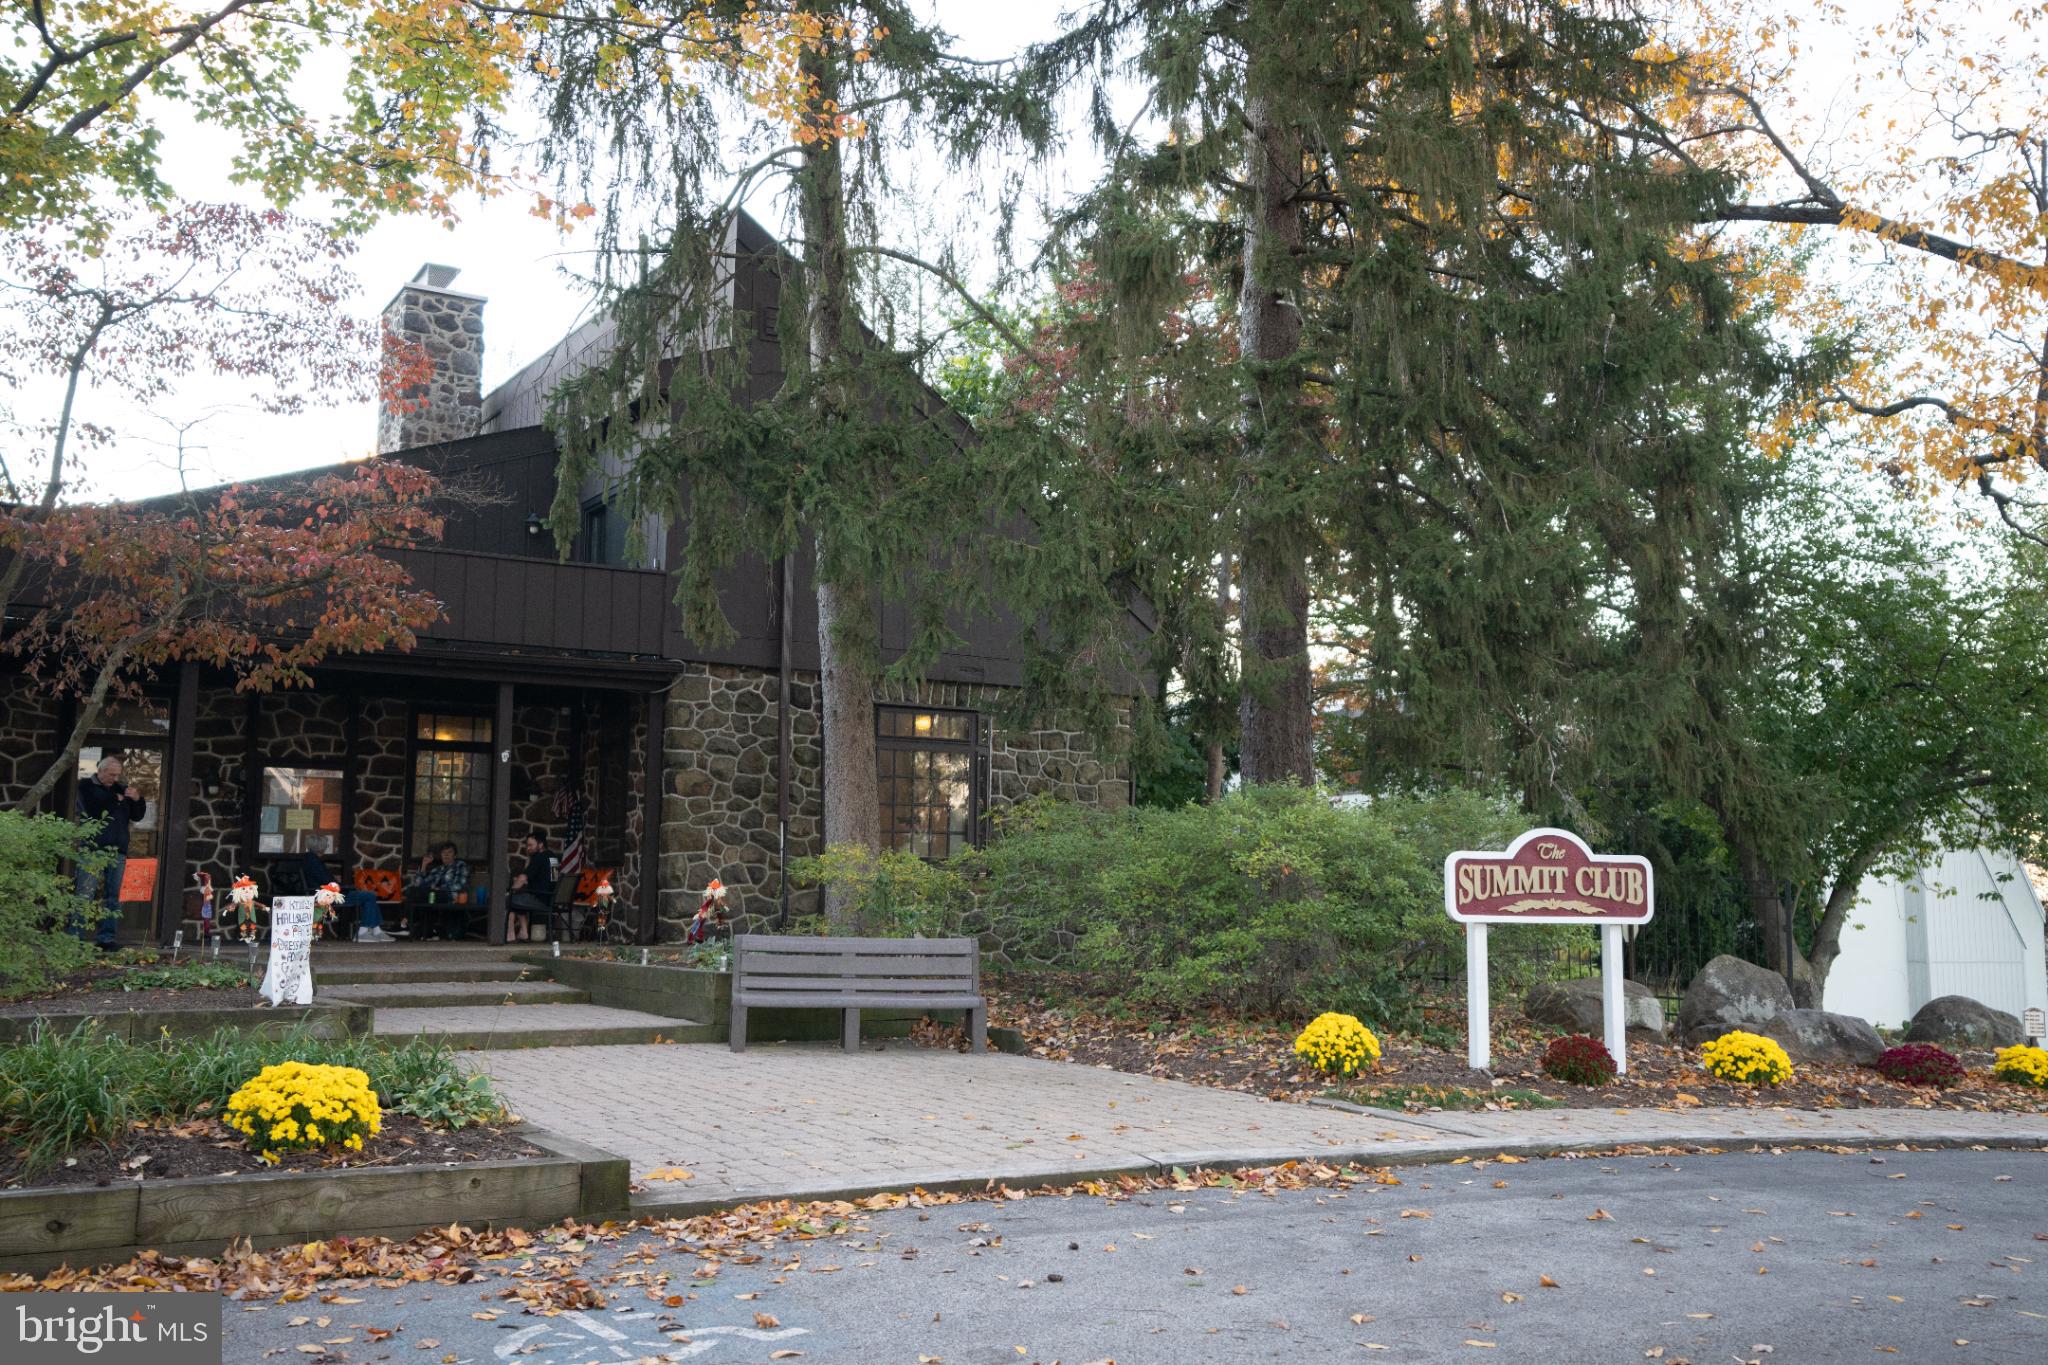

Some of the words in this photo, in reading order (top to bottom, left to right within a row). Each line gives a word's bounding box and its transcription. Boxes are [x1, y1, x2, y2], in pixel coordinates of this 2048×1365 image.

[1537, 842, 1566, 860] The
[1458, 864, 1569, 905] SUMMIT
[1575, 866, 1644, 905] CLUB
